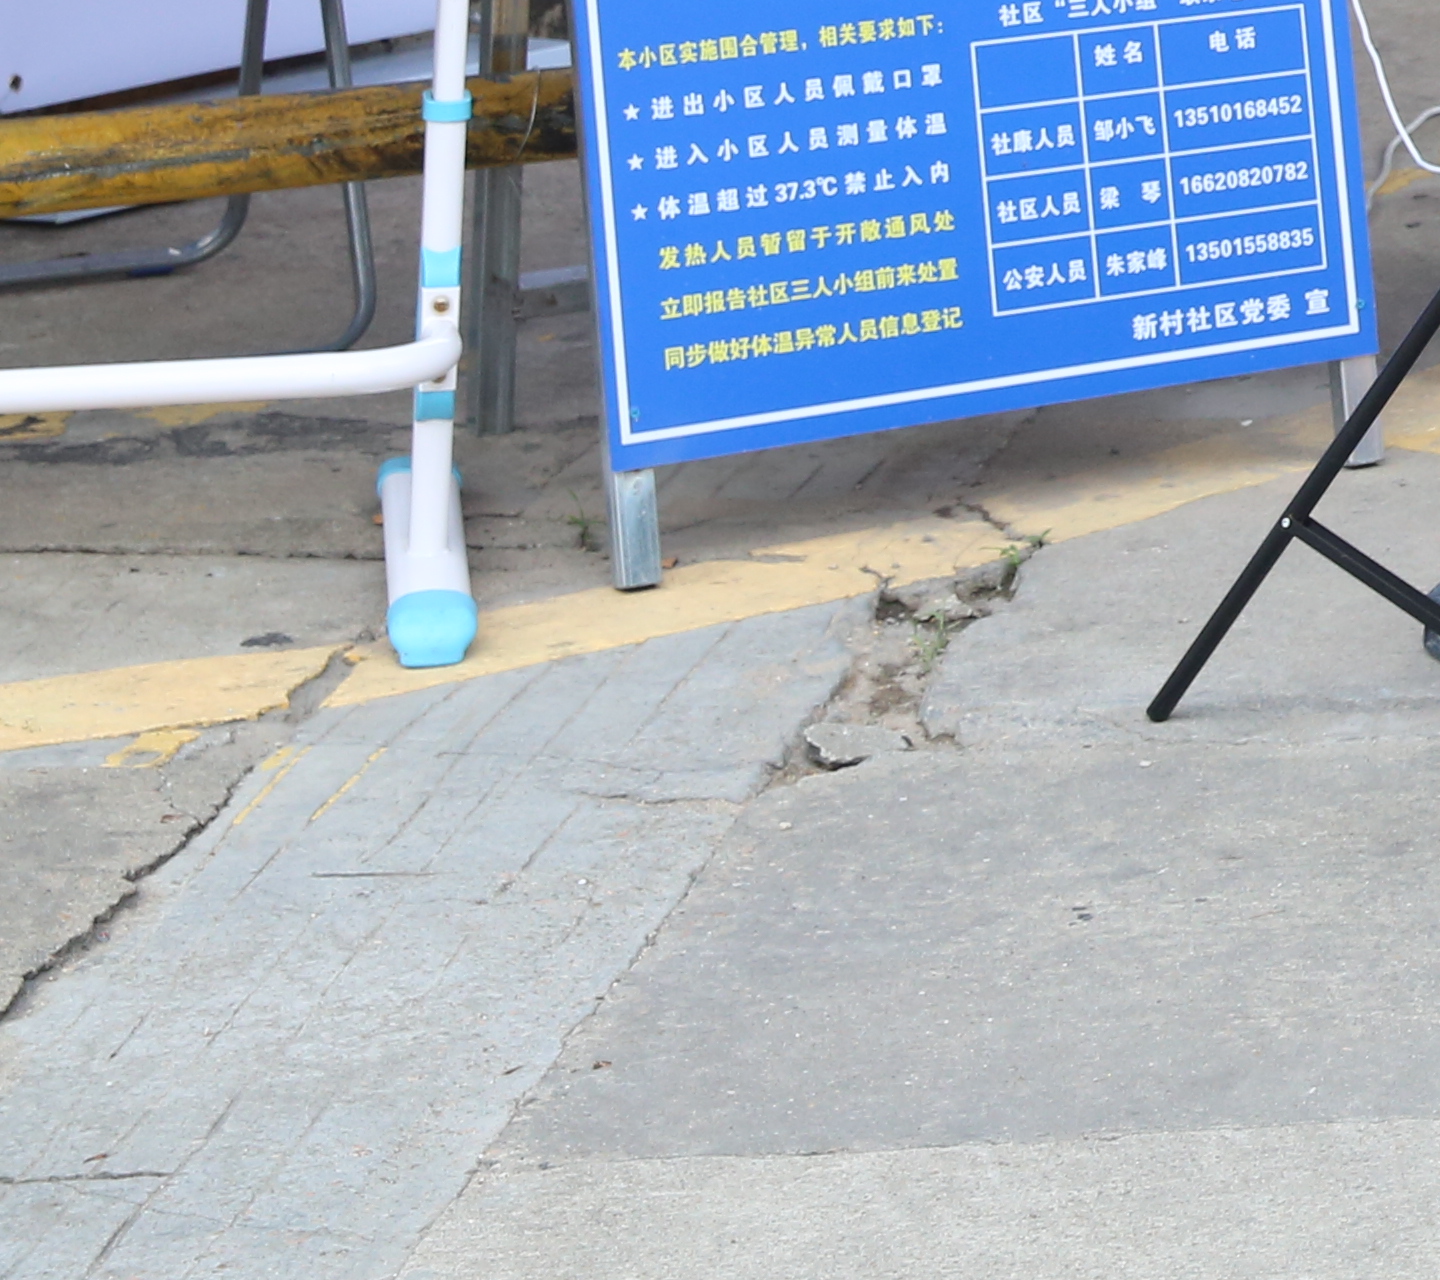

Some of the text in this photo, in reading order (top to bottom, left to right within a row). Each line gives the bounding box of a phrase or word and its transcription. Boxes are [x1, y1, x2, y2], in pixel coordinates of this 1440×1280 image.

[1093, 26, 1258, 67] 姓名 电话
[651, 63, 943, 121] 进出小区人员佩戴口罩
[655, 112, 948, 170] 进入小区人员测量体温
[991, 94, 1303, 156] 社康人员 邹小飞 13510168452
[996, 191, 1081, 224] 社区人员
[1179, 161, 1309, 196] 16620820782
[658, 209, 956, 271] 发热人员暂留于开敞通风处
[1002, 227, 1314, 292] 公安人员 朱家峰 13501558835
[660, 257, 959, 320] 立即报告社区三人小组前来处置
[1132, 288, 1331, 341] 新村社区党委 宣
[664, 306, 964, 371] 同步做好体温异常人员信息登记
